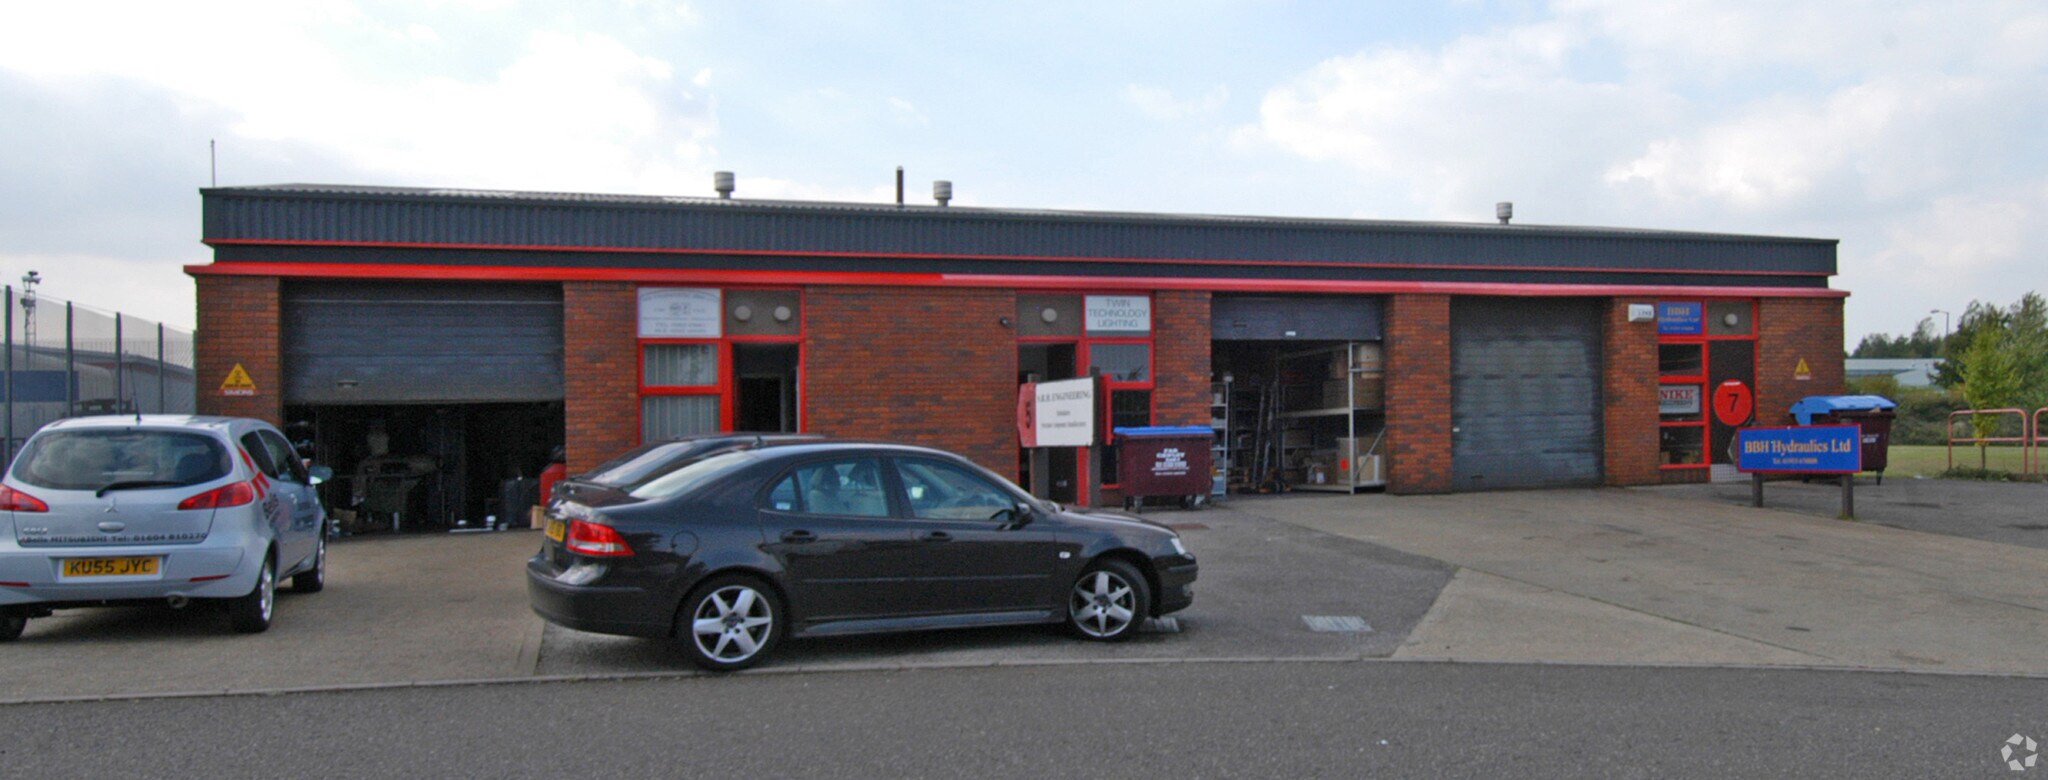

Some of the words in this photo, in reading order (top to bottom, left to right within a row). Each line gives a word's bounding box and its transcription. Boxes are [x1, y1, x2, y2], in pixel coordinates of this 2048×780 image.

[1106, 298, 1131, 307] TWIN
[1089, 308, 1147, 317] TECHNOLOGY
[1667, 306, 1690, 315] BBH
[1097, 319, 1138, 328] LIGHTING
[1052, 390, 1091, 402] ENGINEERING
[1660, 389, 1694, 400] NIKE
[1728, 392, 1739, 413] 7
[1744, 440, 1770, 453] BBH
[1772, 438, 1829, 457] Hydraulics
[1831, 438, 1852, 453] Ltd
[133, 534, 166, 542] 01604
[70, 559, 115, 575] KU55
[120, 558, 152, 574] JYC
